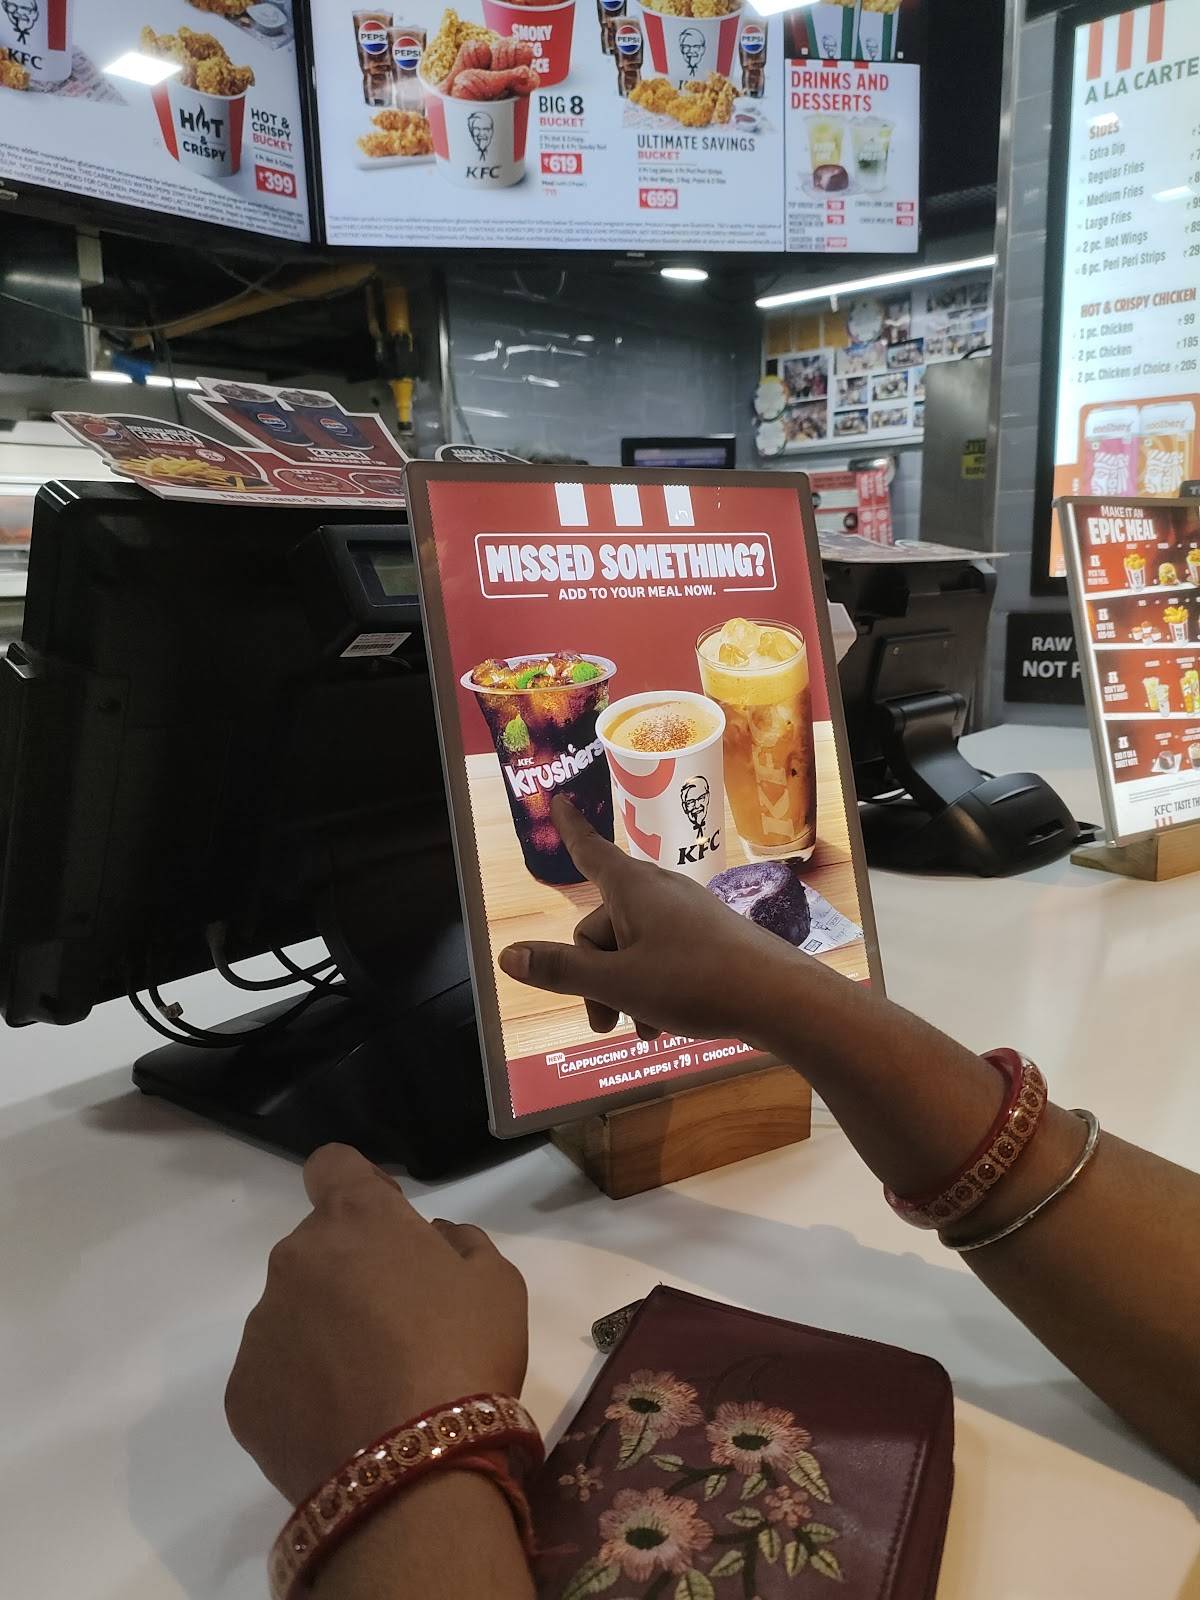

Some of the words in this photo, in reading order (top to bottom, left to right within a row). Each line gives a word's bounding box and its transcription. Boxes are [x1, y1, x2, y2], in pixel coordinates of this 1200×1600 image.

[511, 23, 552, 41] SMOKY
[617, 36, 640, 44] PEPSI
[8, 48, 43, 71] KFC
[394, 49, 422, 57] PEPSI
[790, 70, 852, 90] DRINKS
[856, 73, 890, 91] AND
[1084, 86, 1099, 105] A
[1103, 77, 1129, 100] LA
[1133, 56, 1200, 91] CARTE
[538, 95, 565, 114] BIG
[569, 95, 585, 116] 8
[790, 92, 873, 112] DESSERTS
[251, 107, 278, 126] HOT
[281, 116, 290, 130] &
[539, 117, 585, 128] BUCKET
[200, 135, 208, 146] &
[251, 121, 291, 142] CRISPY
[182, 140, 227, 163] CRISPY
[252, 132, 294, 153] BUCKET
[637, 134, 699, 151] ULTIMATE
[701, 136, 757, 153] SAVINGS
[637, 150, 681, 161] BUCKET
[465, 165, 502, 180] KFC
[1087, 168, 1122, 184] Regular
[1123, 161, 1145, 176] Fries
[1122, 185, 1144, 200] Fries
[1085, 214, 1109, 230] Large
[1110, 210, 1132, 226] Fries
[1104, 234, 1119, 248] Hot
[1121, 231, 1149, 246] Wings
[1141, 251, 1166, 265] Strips
[1080, 303, 1101, 318] HOT
[1102, 301, 1112, 314] &
[1113, 294, 1150, 313] CRISPY
[1152, 287, 1197, 306] CHICKEN
[1100, 321, 1134, 337] Chicken
[1099, 344, 1133, 358] Chicken
[1098, 365, 1132, 381] Chicken
[1143, 361, 1171, 376] Choice
[324, 450, 365, 458] PEPSI
[1101, 505, 1127, 519] MAKE
[1133, 507, 1144, 518] AN
[1087, 517, 1126, 546] EPIC
[1125, 518, 1157, 541] MEAL
[485, 544, 595, 583] MISSED
[599, 543, 765, 581] SOMETHING?
[558, 588, 588, 600] ADD
[588, 587, 608, 599] TO
[610, 586, 646, 599] YOUR
[648, 585, 683, 598] MEAL
[684, 584, 717, 597] NOW.
[1031, 636, 1073, 652] RAW
[1022, 660, 1068, 679] NOT
[517, 757, 535, 767] KFC
[1153, 803, 1173, 816] KFC
[1173, 799, 1192, 811] TASTE
[676, 828, 722, 866] KFC
[547, 1054, 564, 1063] NEW
[561, 1049, 629, 1073] CAPPUCCINO
[630, 1040, 650, 1056] ₹99
[599, 1069, 643, 1088] MASALA
[643, 1061, 672, 1077] PEPSI
[673, 1053, 692, 1070] ₹79
[702, 1046, 736, 1062] CHOCO
[736, 1042, 754, 1054] LA
